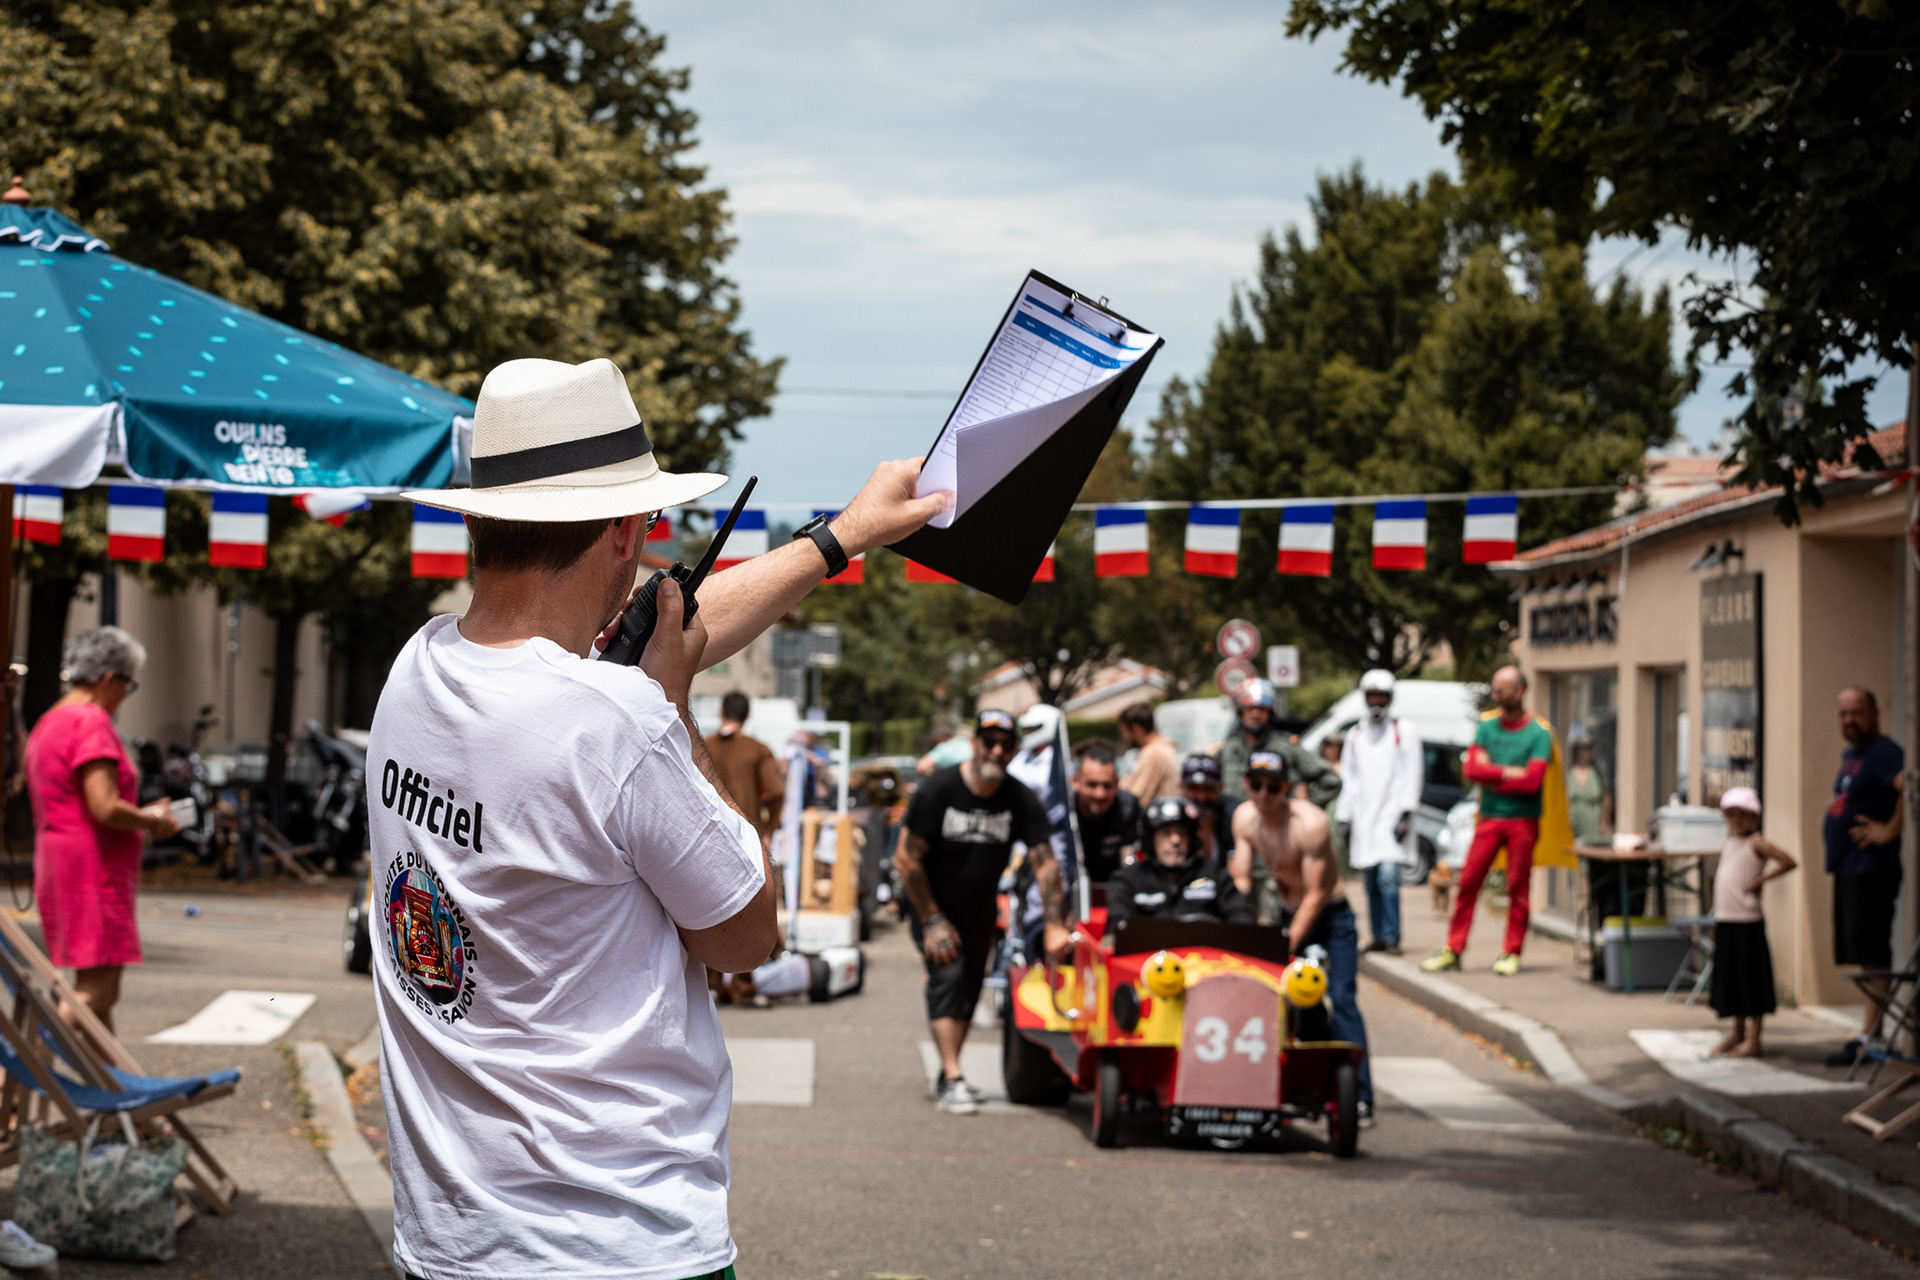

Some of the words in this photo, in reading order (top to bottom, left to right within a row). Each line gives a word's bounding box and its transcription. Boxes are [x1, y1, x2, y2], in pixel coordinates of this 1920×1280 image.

[381, 758, 484, 854] Officiel
[383, 850, 405, 924] COMITÉ
[406, 851, 423, 869] DU
[424, 860, 478, 962] LYONNAIS
[387, 940, 434, 1017] CAISSES
[441, 976, 477, 1026] SAVON
[1194, 1016, 1268, 1064] 34
